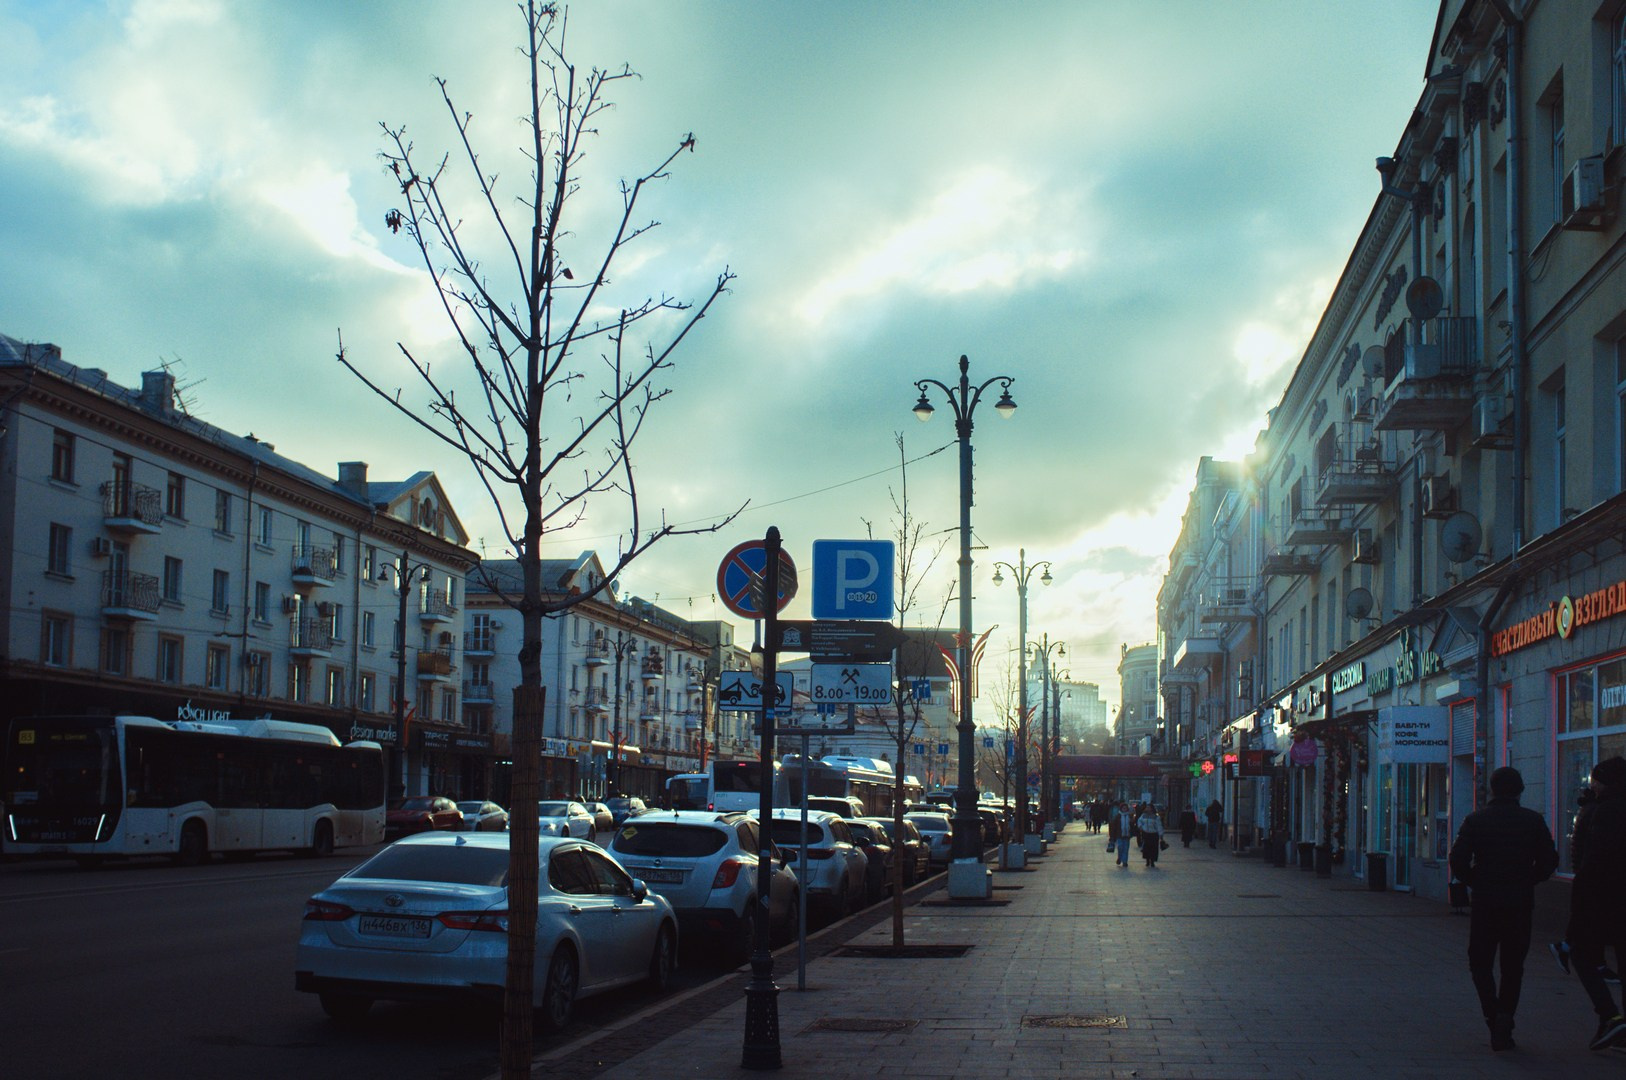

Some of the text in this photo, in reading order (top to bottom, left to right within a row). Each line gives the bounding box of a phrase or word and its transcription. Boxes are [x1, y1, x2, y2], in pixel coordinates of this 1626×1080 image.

[836, 549, 879, 610] P
[865, 593, 875, 601] 20
[1420, 649, 1440, 677] VAPE
[350, 720, 397, 741] design marke
